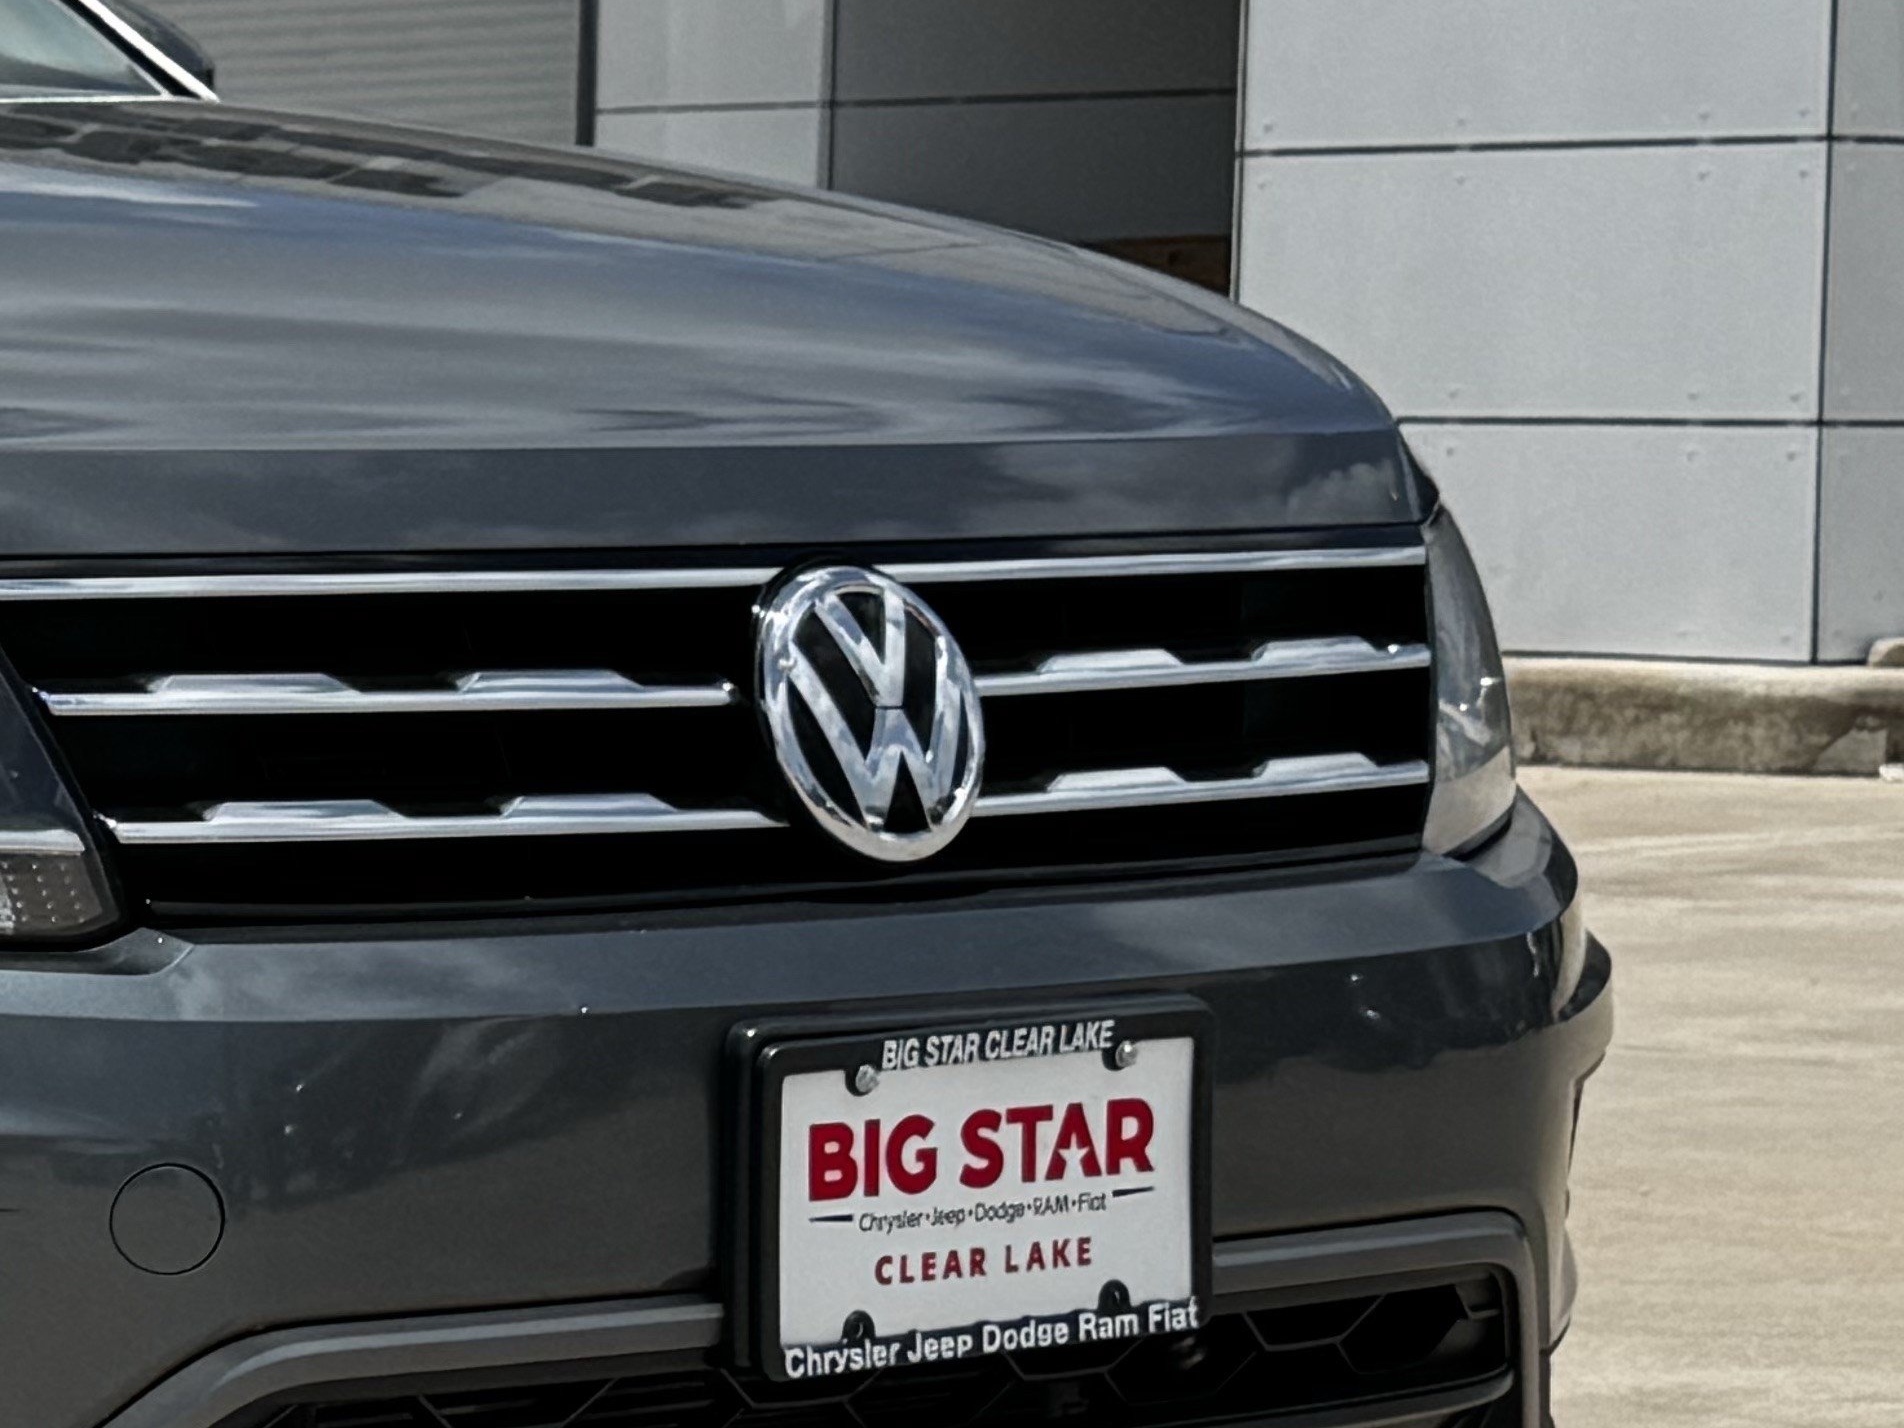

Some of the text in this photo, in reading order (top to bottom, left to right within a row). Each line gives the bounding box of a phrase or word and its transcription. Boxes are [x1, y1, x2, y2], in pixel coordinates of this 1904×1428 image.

[772, 574, 976, 844] VW
[881, 1019, 1115, 1070] BIG STAR CLEAR LAKE
[808, 1098, 1155, 1202] BIG STAR
[874, 1236, 1092, 1285] CLEAR LAKE
[784, 1296, 1200, 1379] Chrysler Jeep Dodge Ram Fiat
